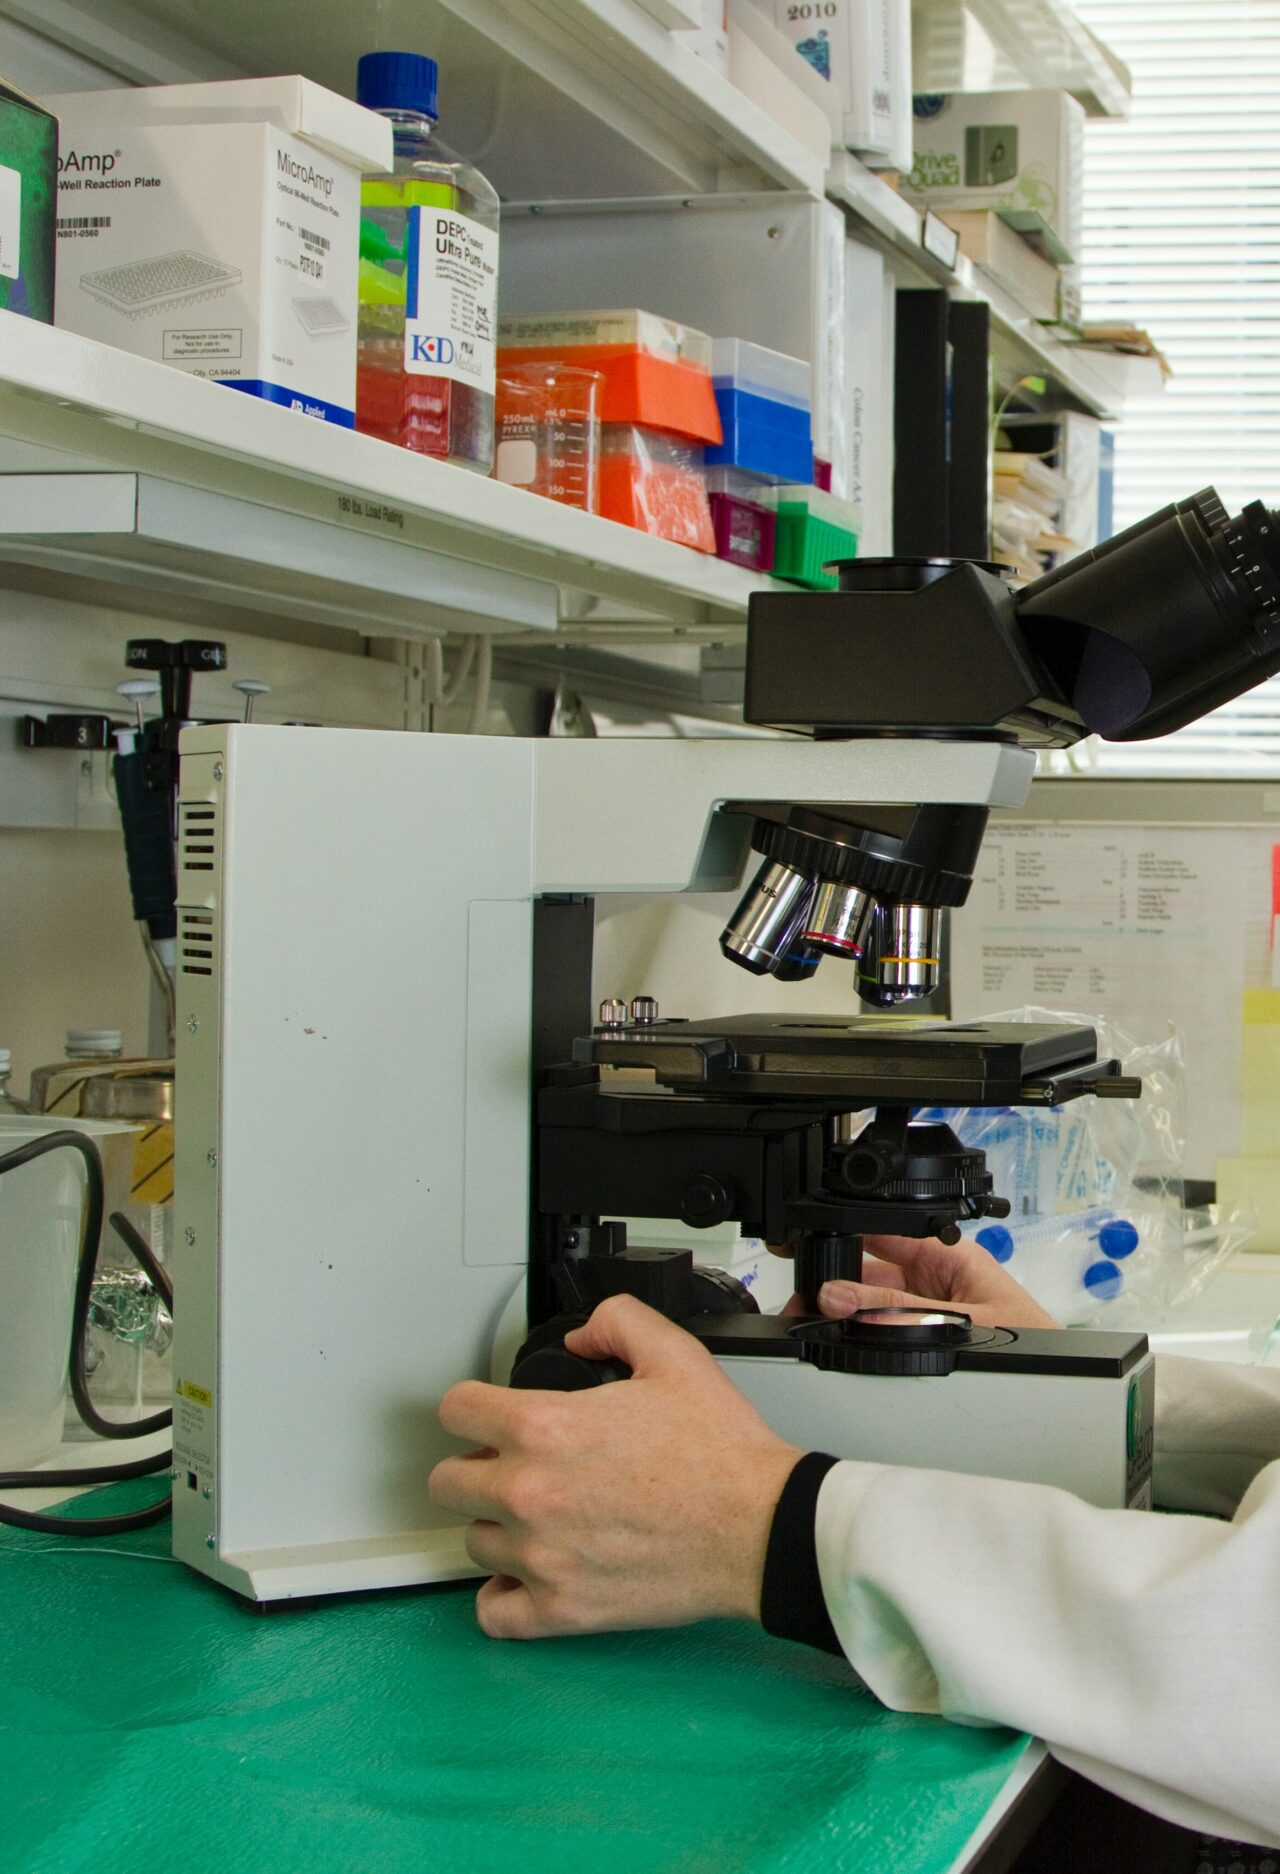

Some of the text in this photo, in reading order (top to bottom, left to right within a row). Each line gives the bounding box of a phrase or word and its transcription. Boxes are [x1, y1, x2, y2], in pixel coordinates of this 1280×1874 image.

[787, 2, 837, 20] 2010
[85, 178, 131, 190] Reaction
[134, 177, 161, 188] Plate
[57, 229, 99, 239] N801-0560
[436, 219, 466, 242] DEPC
[436, 237, 462, 259] Ultra
[464, 247, 482, 269] Pure
[208, 368, 219, 376] CA
[220, 368, 241, 376] 94404
[304, 404, 326, 419] Applied
[545, 408, 558, 417] mL
[553, 432, 566, 441] 50
[549, 459, 565, 468] 100
[548, 486, 565, 495] 150
[365, 500, 381, 520] Load
[382, 505, 403, 528] Rating
[78, 727, 87, 743] 3
